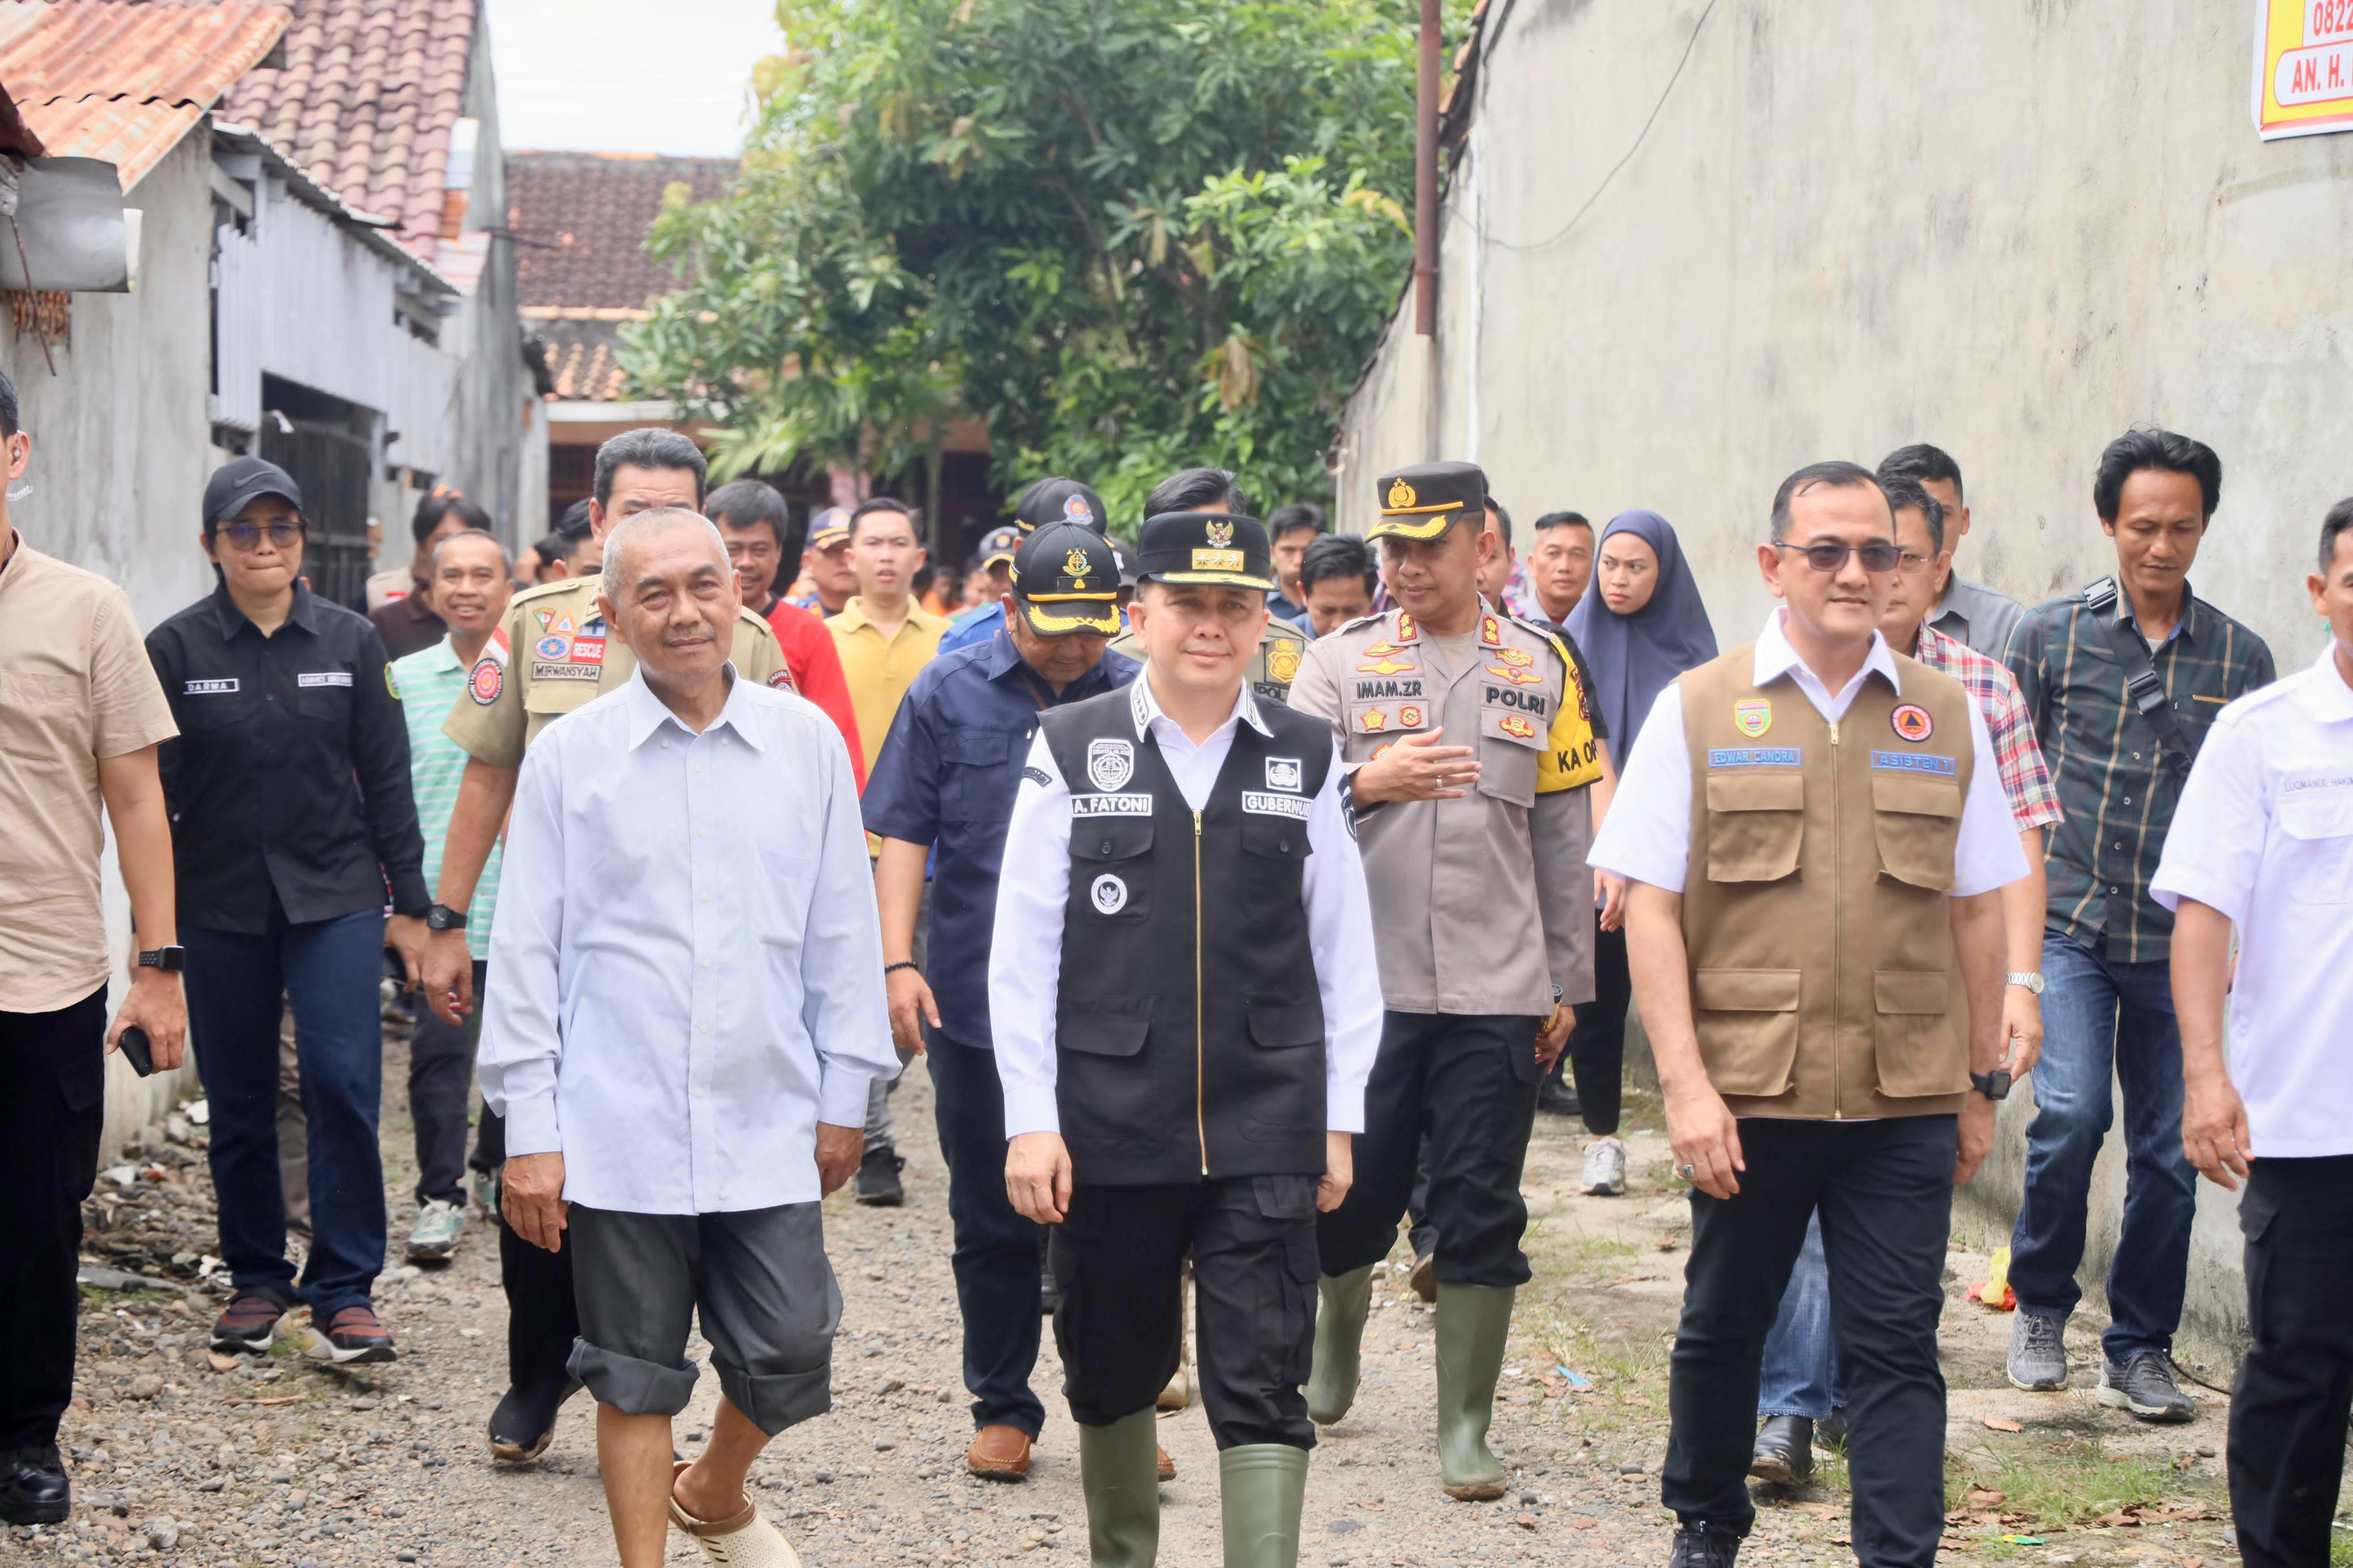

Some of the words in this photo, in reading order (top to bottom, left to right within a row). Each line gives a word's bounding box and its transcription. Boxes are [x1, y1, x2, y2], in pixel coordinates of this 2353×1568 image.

[2291, 58, 2321, 94] AN.
[2328, 54, 2345, 89] H.
[573, 641, 604, 658] RESCUE
[535, 664, 597, 678] MIRWANSYAH
[187, 682, 227, 692] DARMA
[1356, 679, 1422, 699] IMAM.ZR
[1486, 686, 1545, 716] POLRI
[1557, 747, 1581, 773] KA
[1714, 751, 1749, 764] EDWAR
[1755, 750, 1794, 763] CANDRA
[1881, 754, 1940, 771] ASISTEN
[1074, 799, 1088, 813] A.
[1090, 797, 1148, 813] FATONI
[1247, 795, 1311, 816] GUBERNUR
